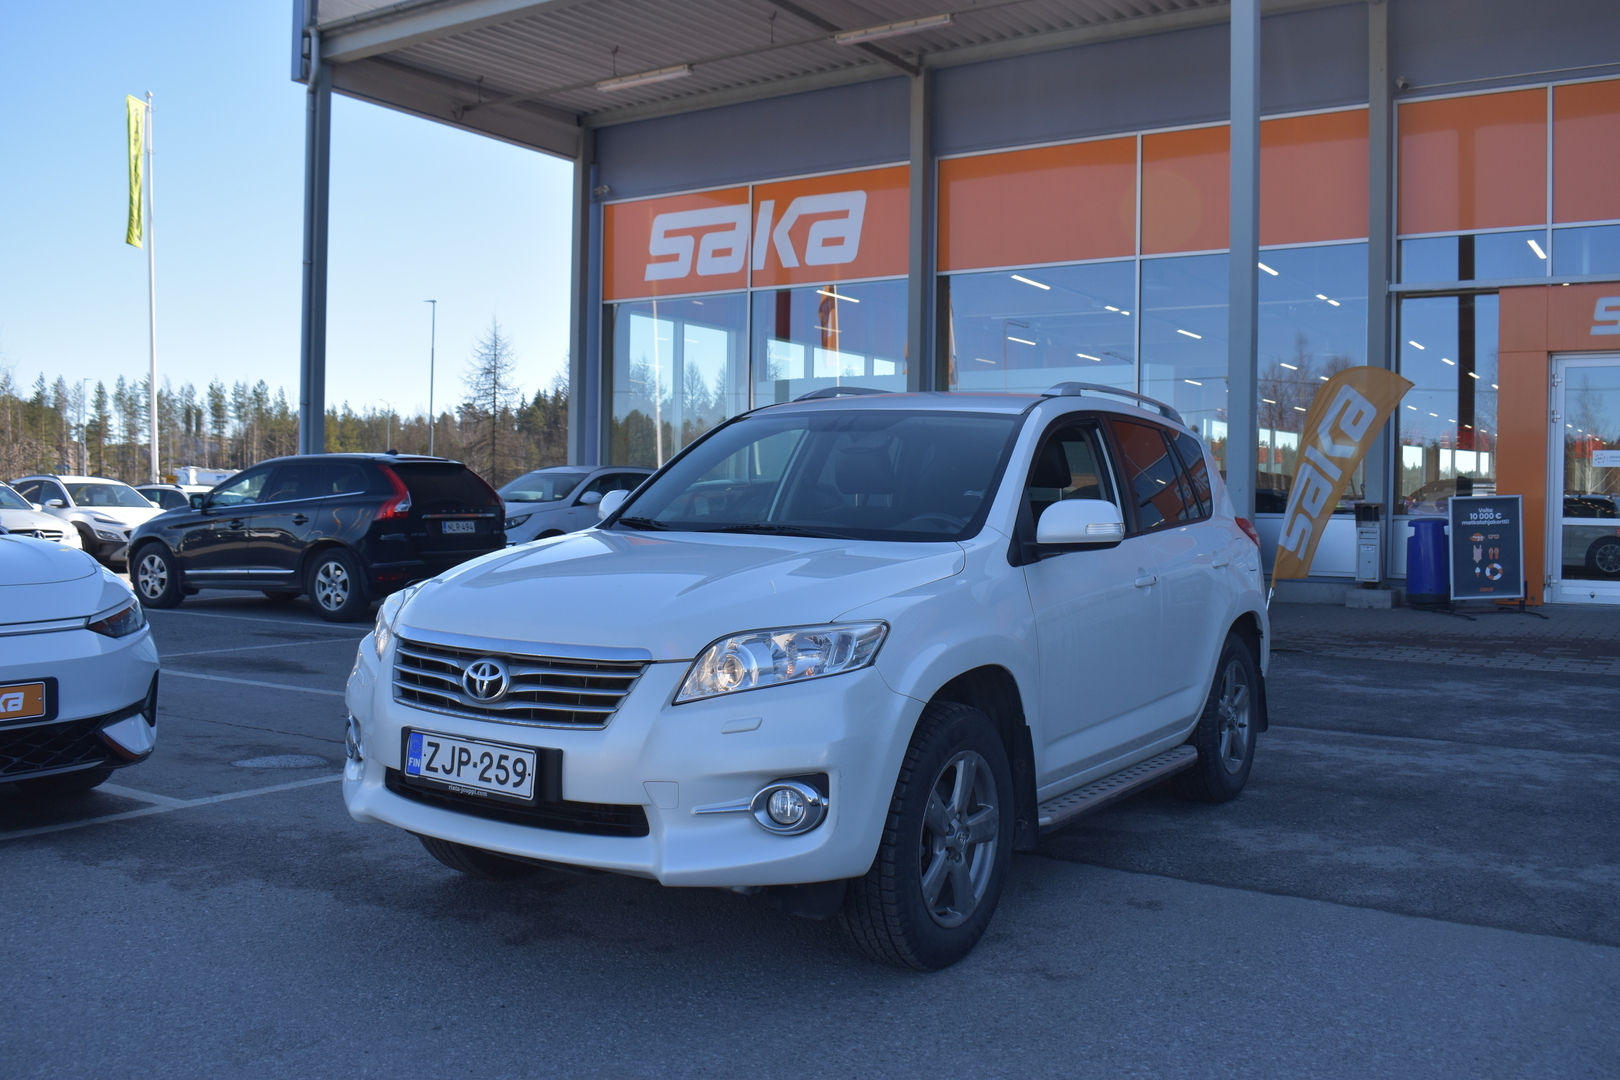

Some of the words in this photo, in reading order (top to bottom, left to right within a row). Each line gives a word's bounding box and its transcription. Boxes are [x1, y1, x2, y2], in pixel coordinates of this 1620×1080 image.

[1479, 512, 1494, 520] 000
[1495, 512, 1502, 520] €
[408, 757, 421, 768] FIN
[425, 741, 527, 788] ZJP-259
